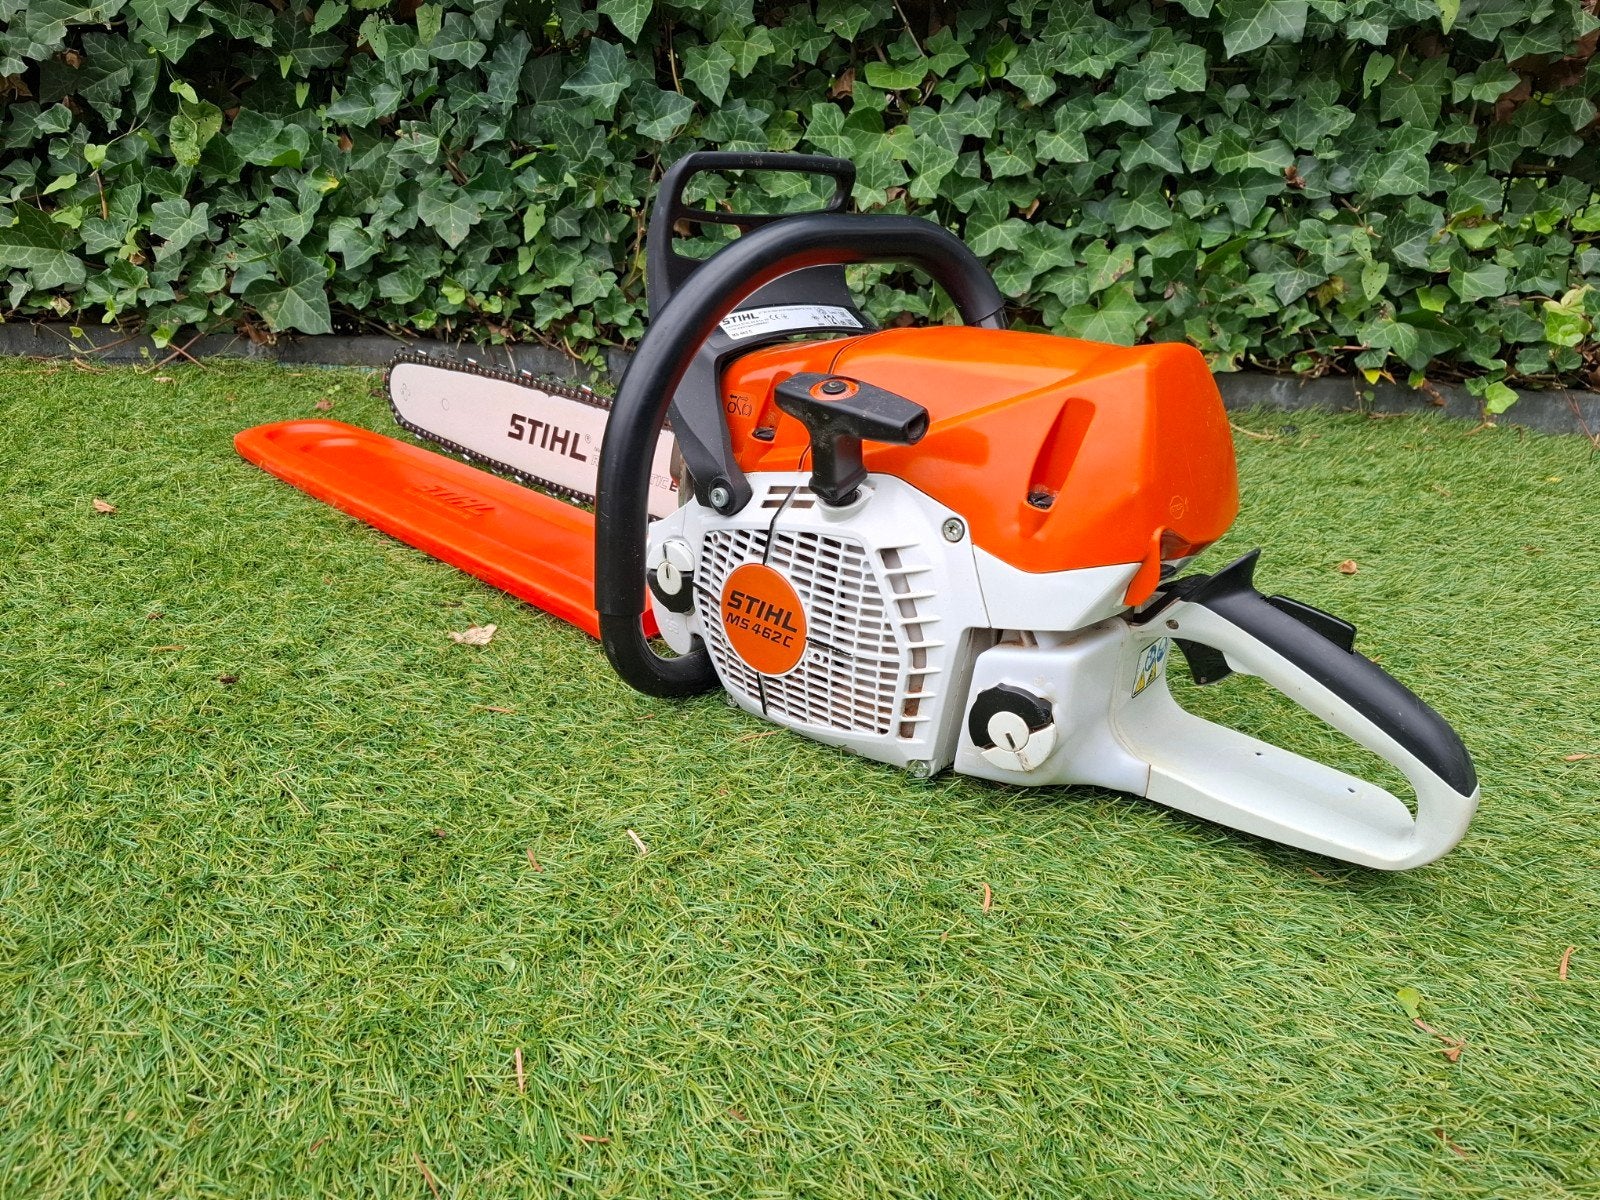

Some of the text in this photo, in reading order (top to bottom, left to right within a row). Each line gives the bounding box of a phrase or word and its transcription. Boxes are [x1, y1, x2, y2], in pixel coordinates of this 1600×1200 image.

[722, 313, 759, 325] STIHL
[508, 413, 586, 462] STIHL
[411, 485, 496, 517] STIHL
[727, 613, 750, 630] MS
[728, 590, 797, 633] STIHL
